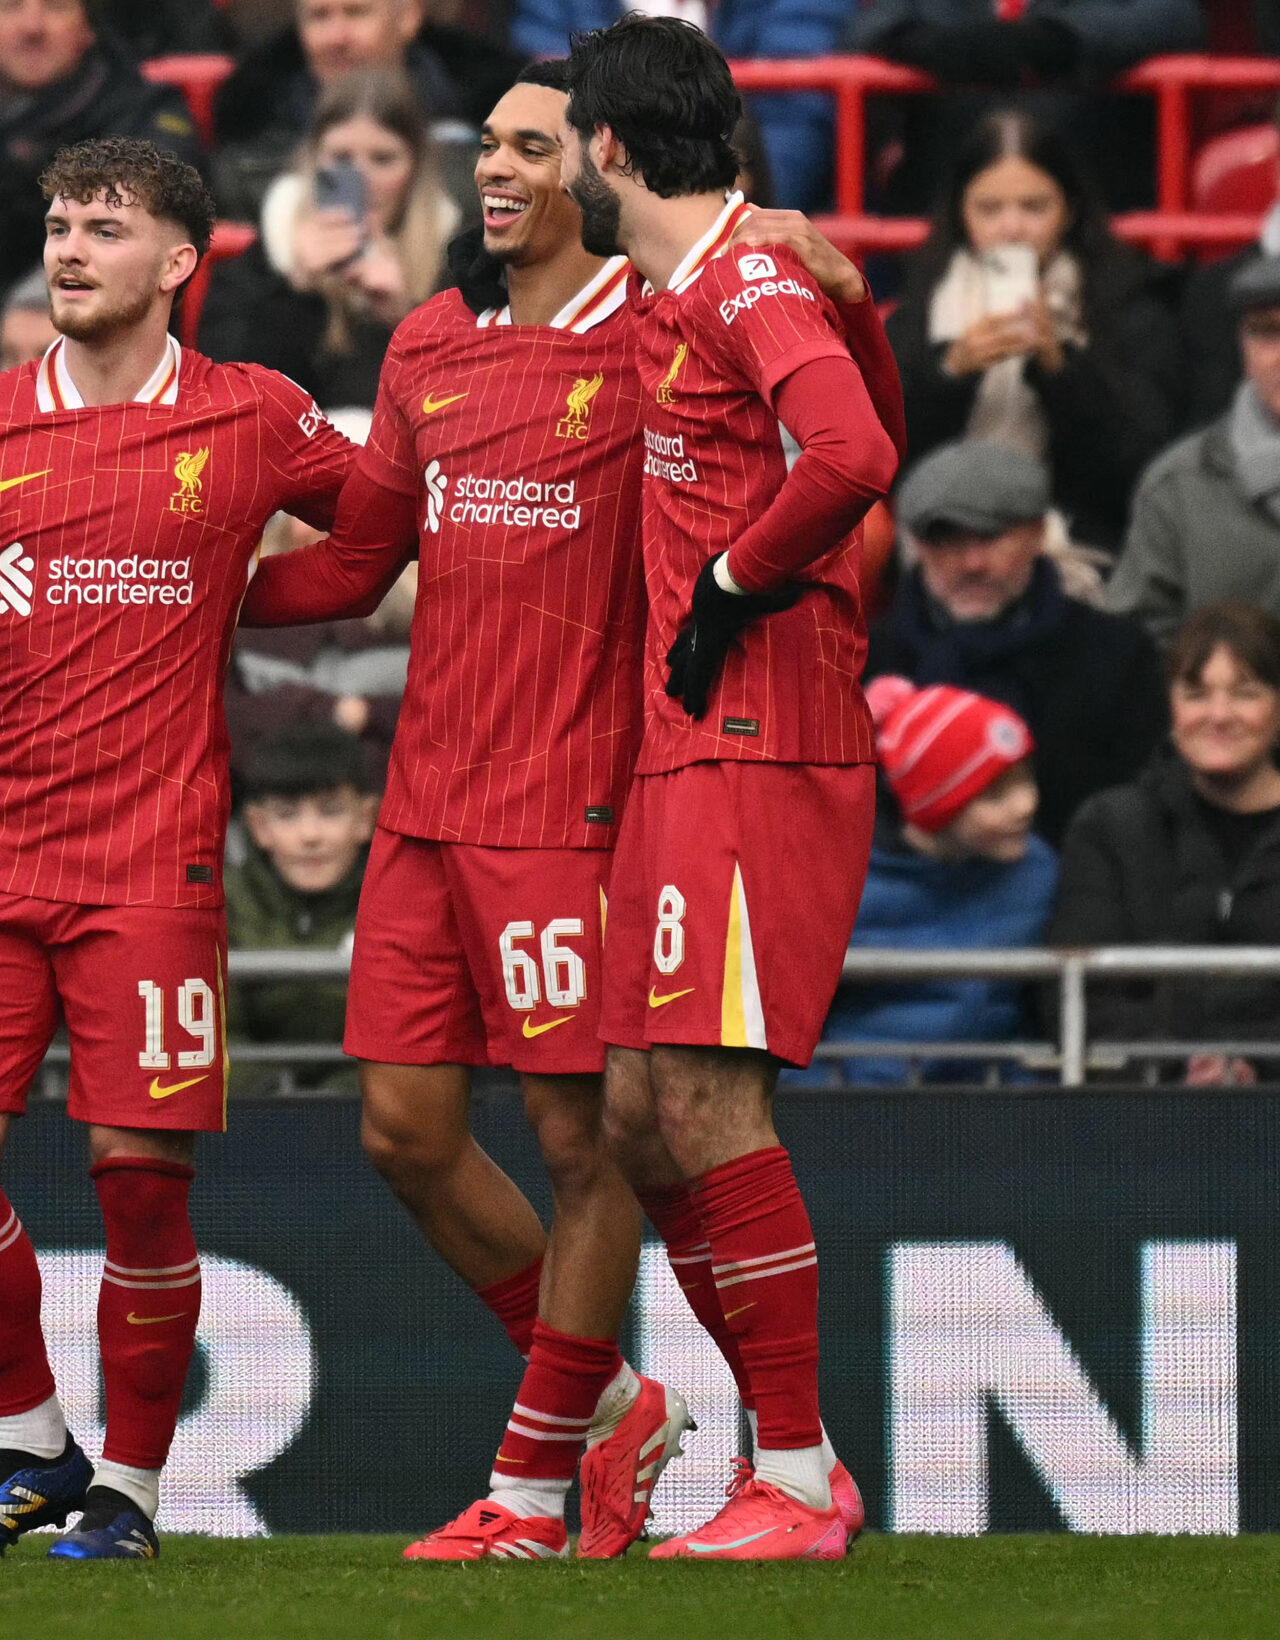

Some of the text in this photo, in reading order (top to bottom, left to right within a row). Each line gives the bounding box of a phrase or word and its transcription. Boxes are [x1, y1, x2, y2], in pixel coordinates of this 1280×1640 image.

[718, 278, 815, 326] Expedia
[454, 473, 575, 504] standard
[450, 499, 581, 530] chartered
[48, 554, 191, 579] standard
[46, 579, 194, 605] chartered
[653, 885, 686, 975] 8
[499, 918, 587, 1011] 66
[138, 978, 216, 1070] 19
